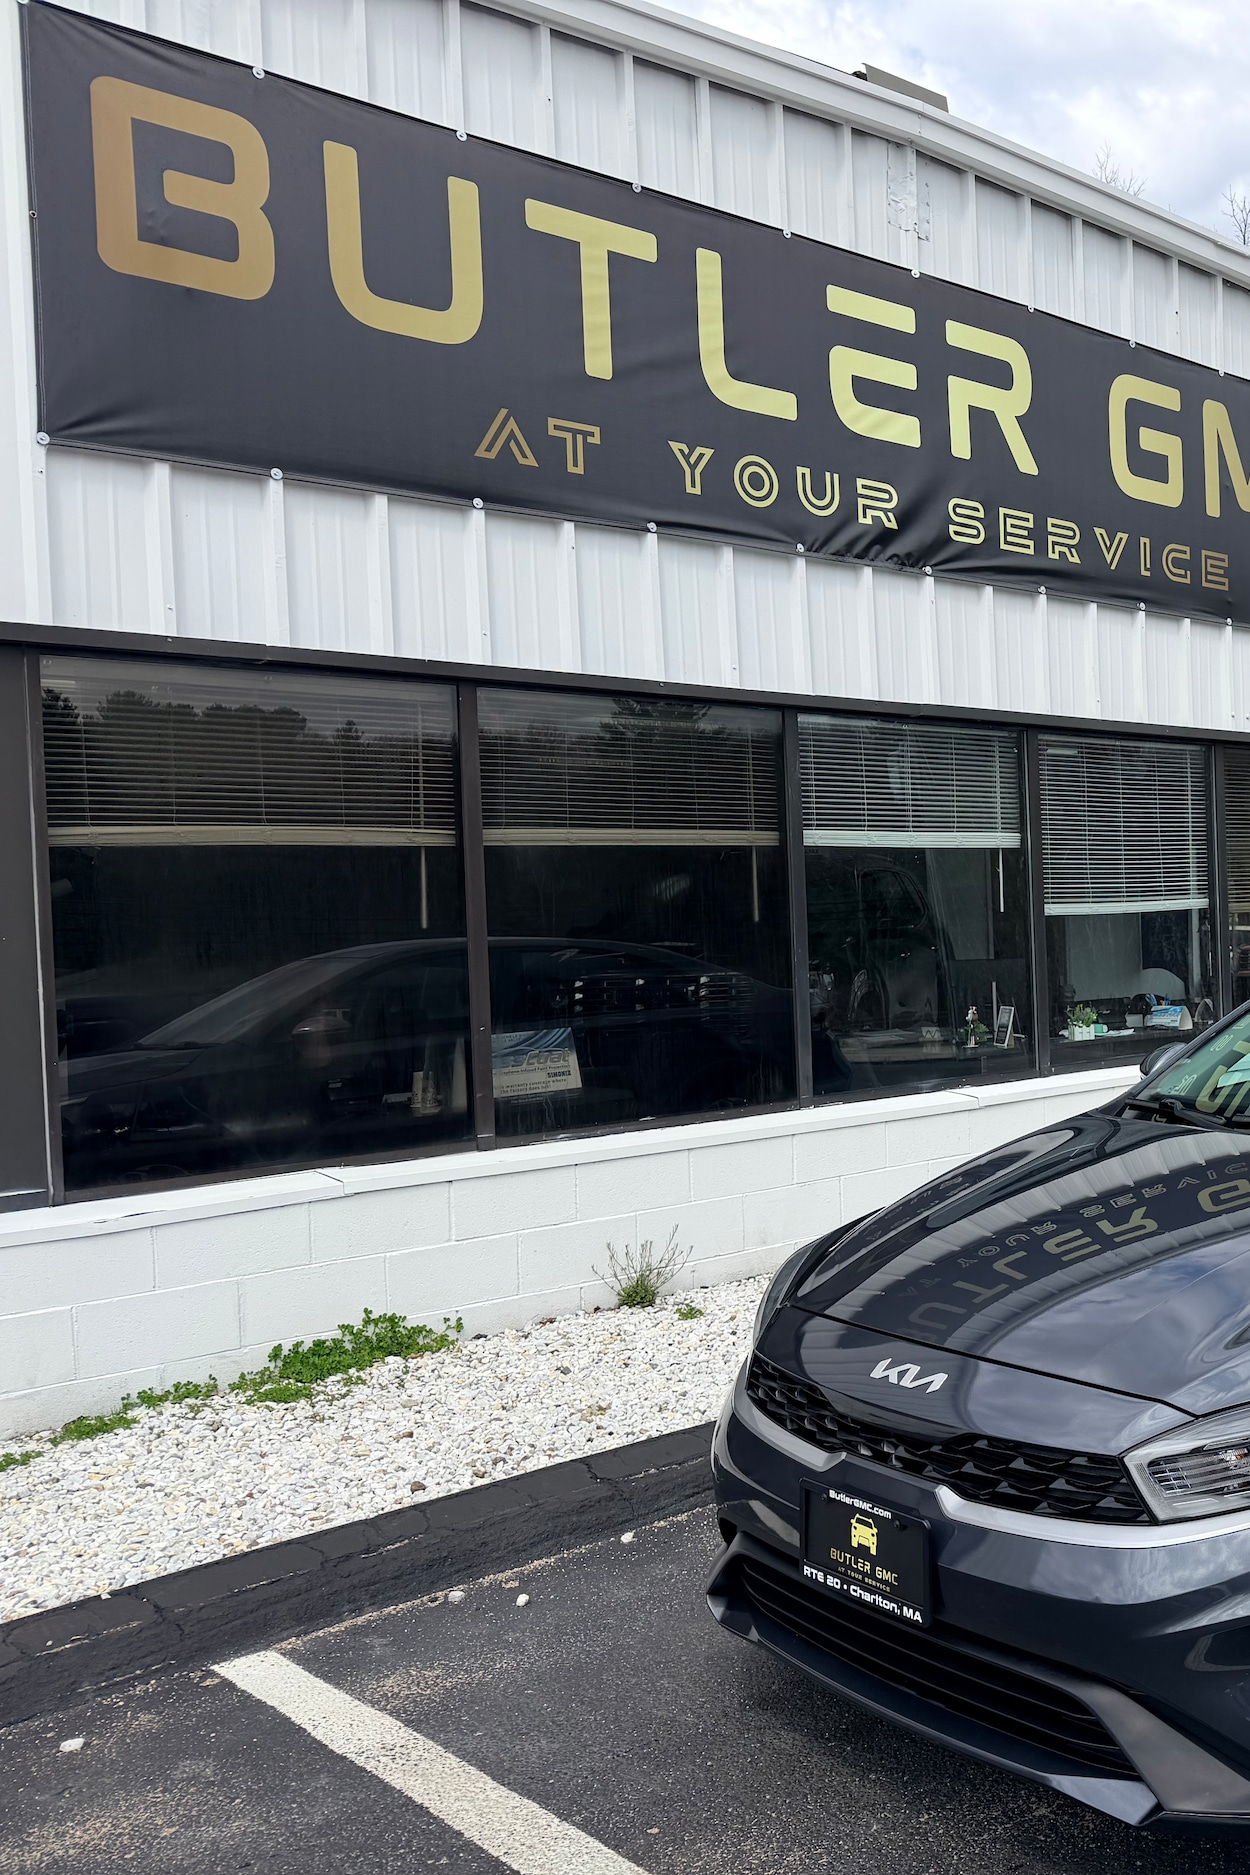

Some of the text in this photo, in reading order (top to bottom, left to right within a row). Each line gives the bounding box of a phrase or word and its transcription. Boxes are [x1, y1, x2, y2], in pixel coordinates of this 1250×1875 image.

[90, 76, 1039, 475] BUTLER
[474, 408, 1229, 591] AT YOUR SERVICE
[829, 1489, 892, 1519] ButlerGMC.com
[803, 1565, 825, 1583] RTE
[826, 1575, 841, 1589] 20
[902, 1605, 923, 1623] MA
[830, 1547, 899, 1585] BUTLER GMC
